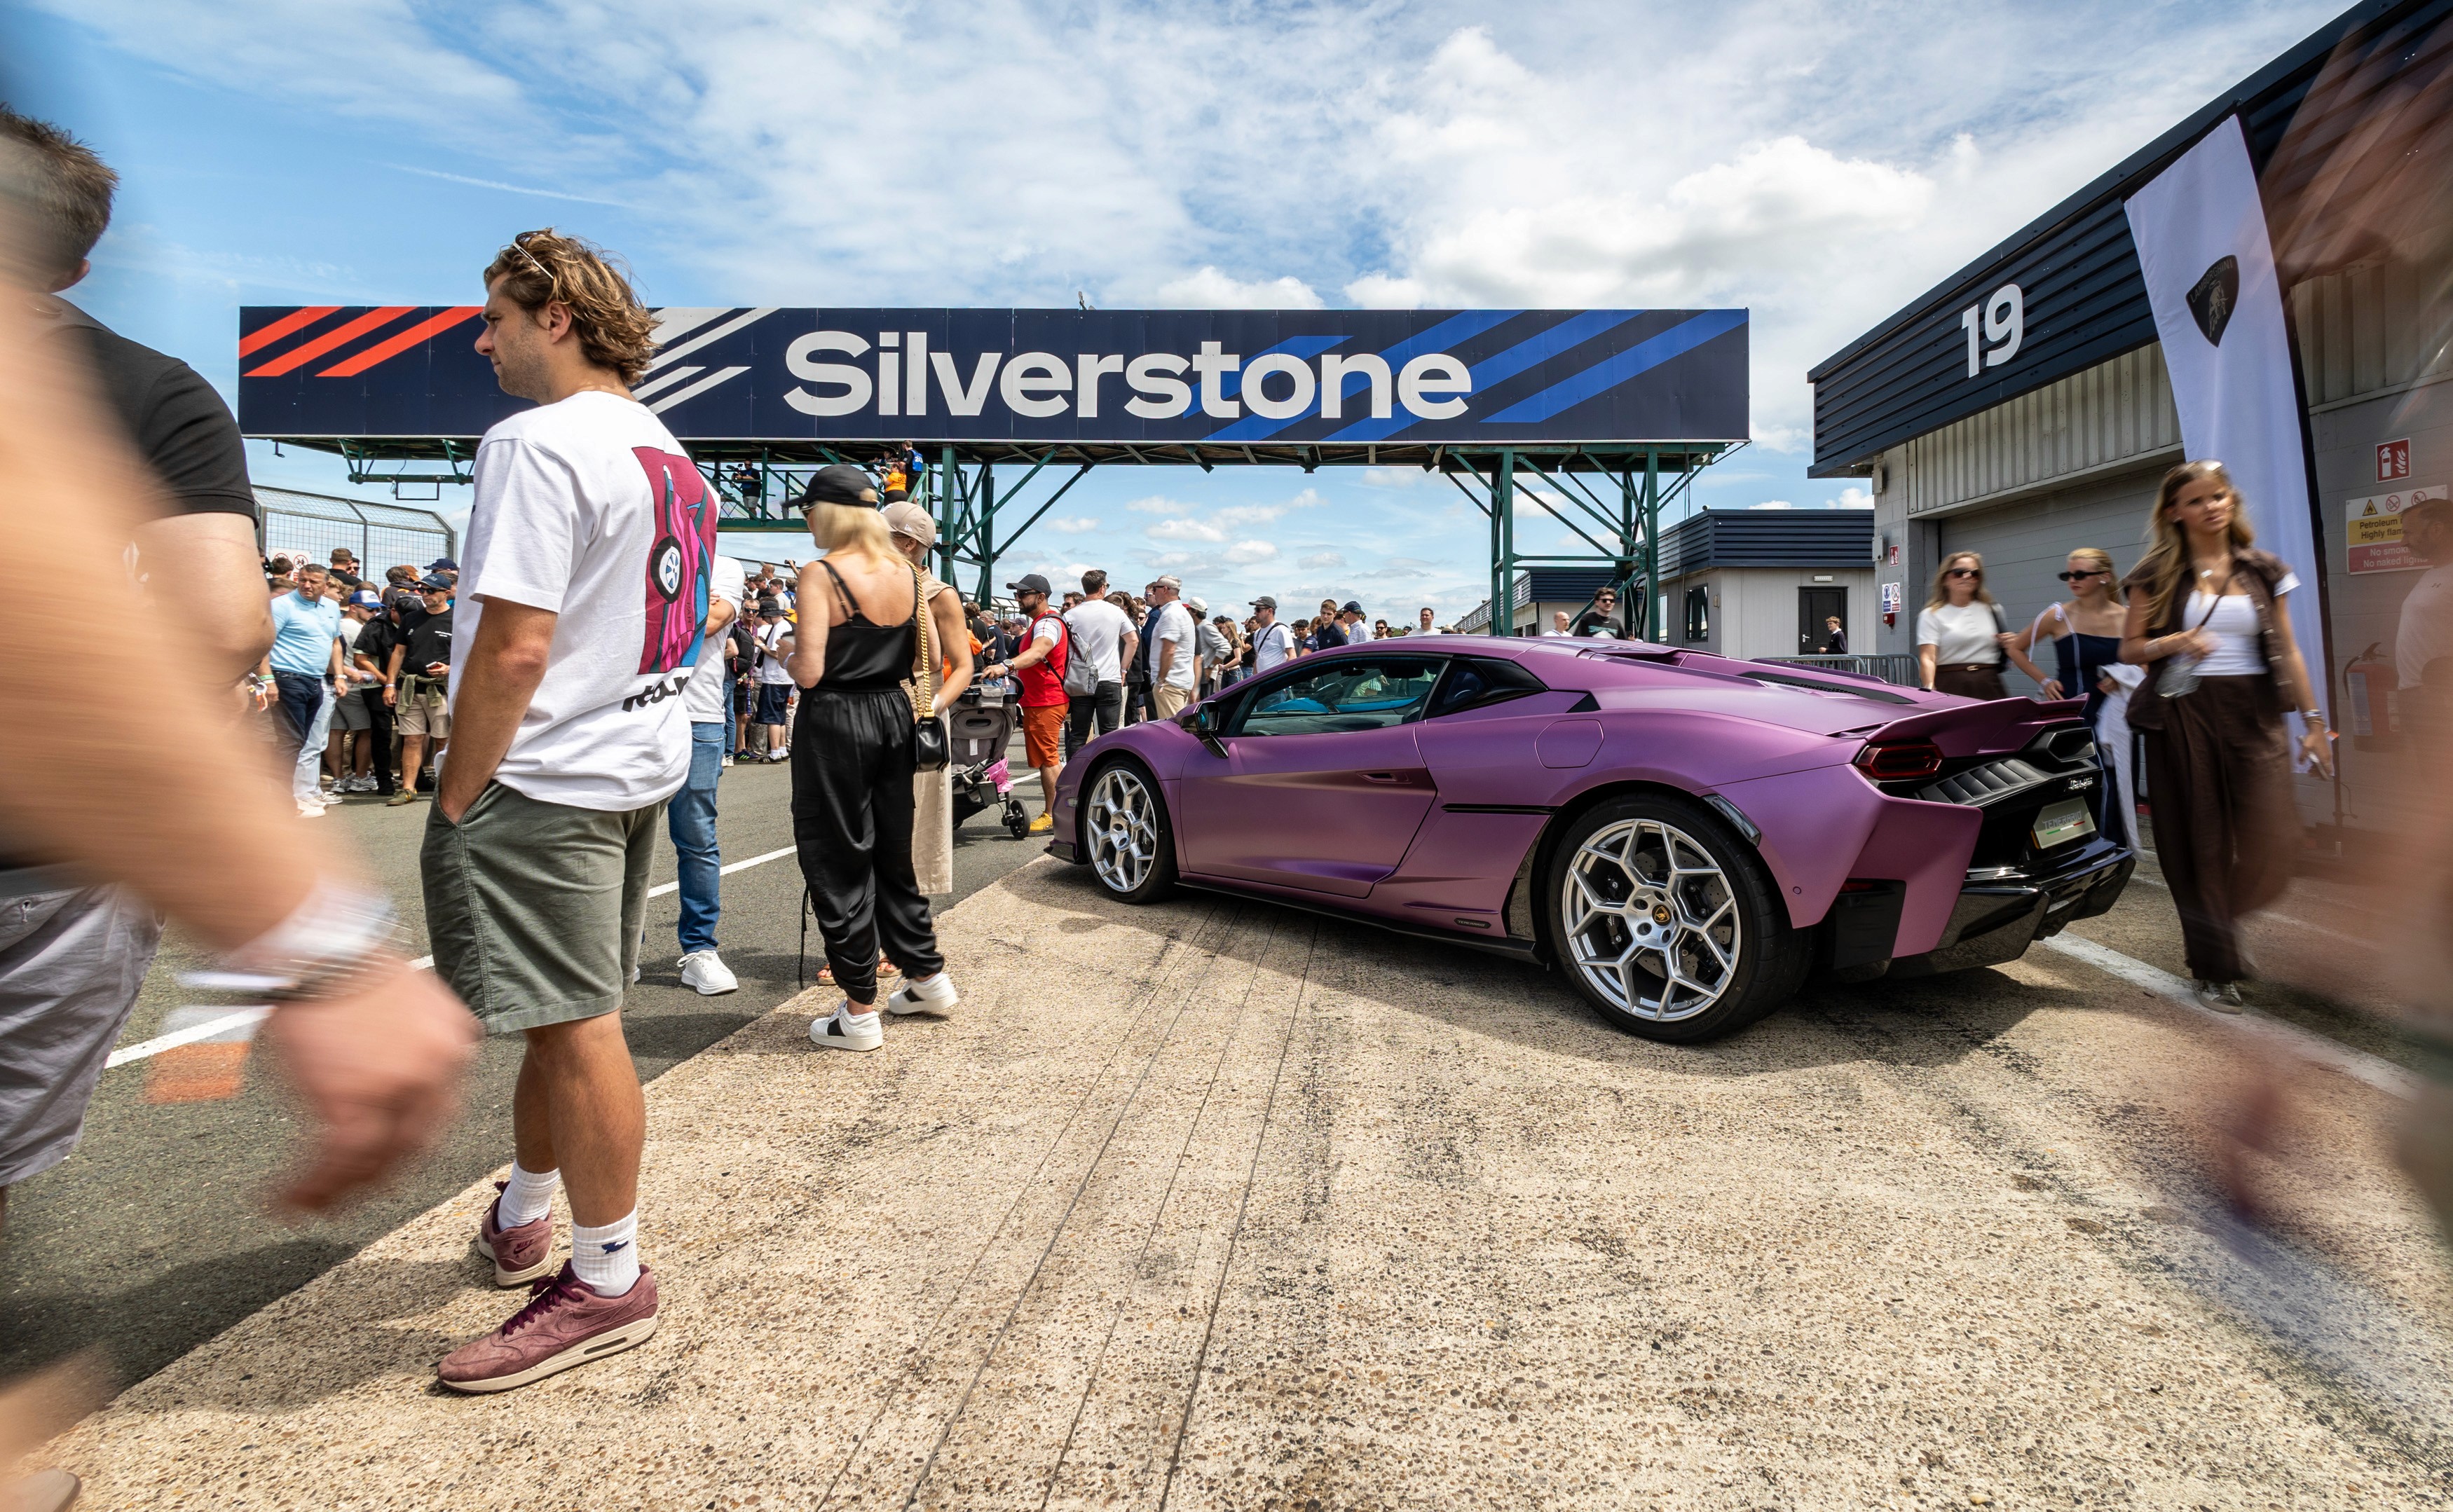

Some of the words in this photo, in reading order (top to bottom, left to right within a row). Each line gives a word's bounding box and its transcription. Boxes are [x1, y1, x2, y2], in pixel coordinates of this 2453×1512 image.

[2189, 259, 2234, 303] LAMBORGHINI
[1962, 284, 2023, 378] 19
[783, 331, 1472, 419] Silverstone
[2359, 518, 2398, 530] Petroleum
[2361, 529, 2385, 539] Highly
[2370, 548, 2382, 557] No
[2377, 557, 2402, 566] naked
[2042, 809, 2082, 830] TEMERARIO
[1678, 1002, 1730, 1035] BRIDGESTONE
